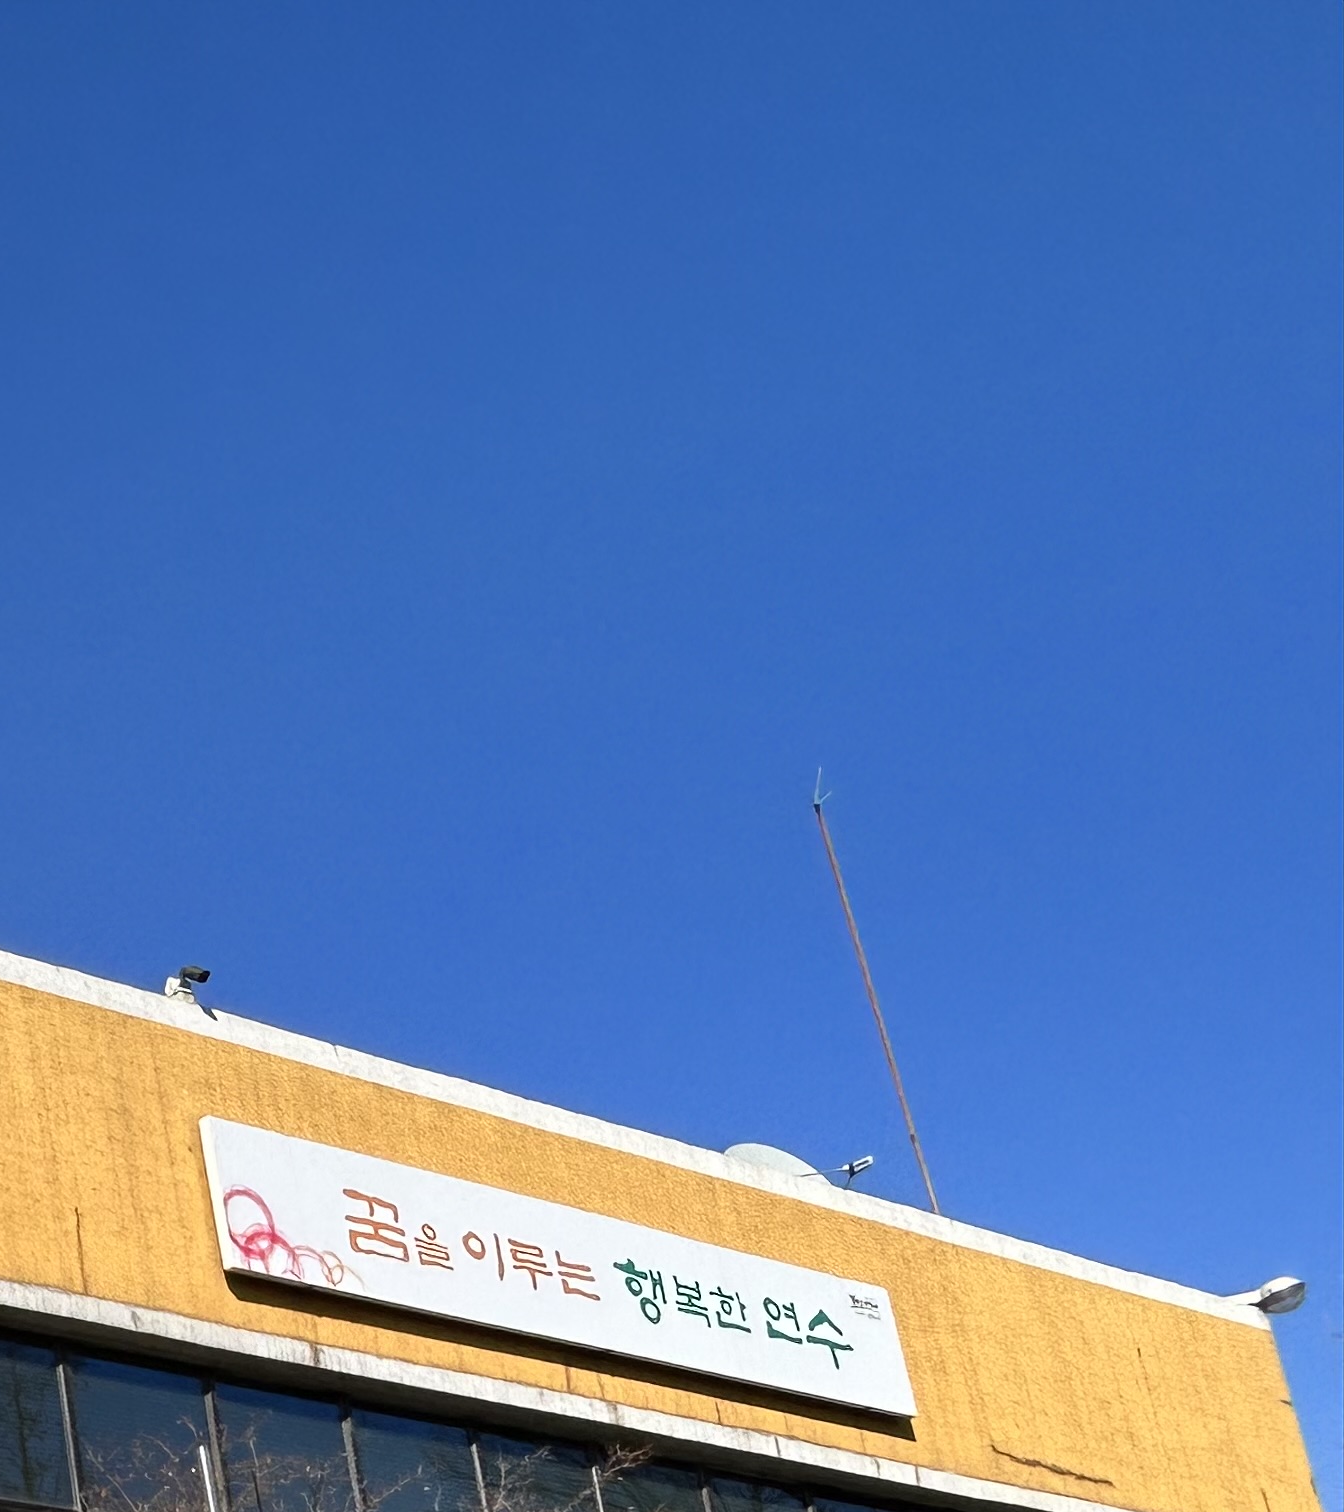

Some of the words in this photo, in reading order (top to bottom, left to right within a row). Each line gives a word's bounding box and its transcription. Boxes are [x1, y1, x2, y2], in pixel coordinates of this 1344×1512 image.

[342, 1188, 454, 1271] 꿈을
[461, 1232, 601, 1301] 이루는
[612, 1257, 752, 1334] 행복한
[761, 1296, 854, 1370] 연수
